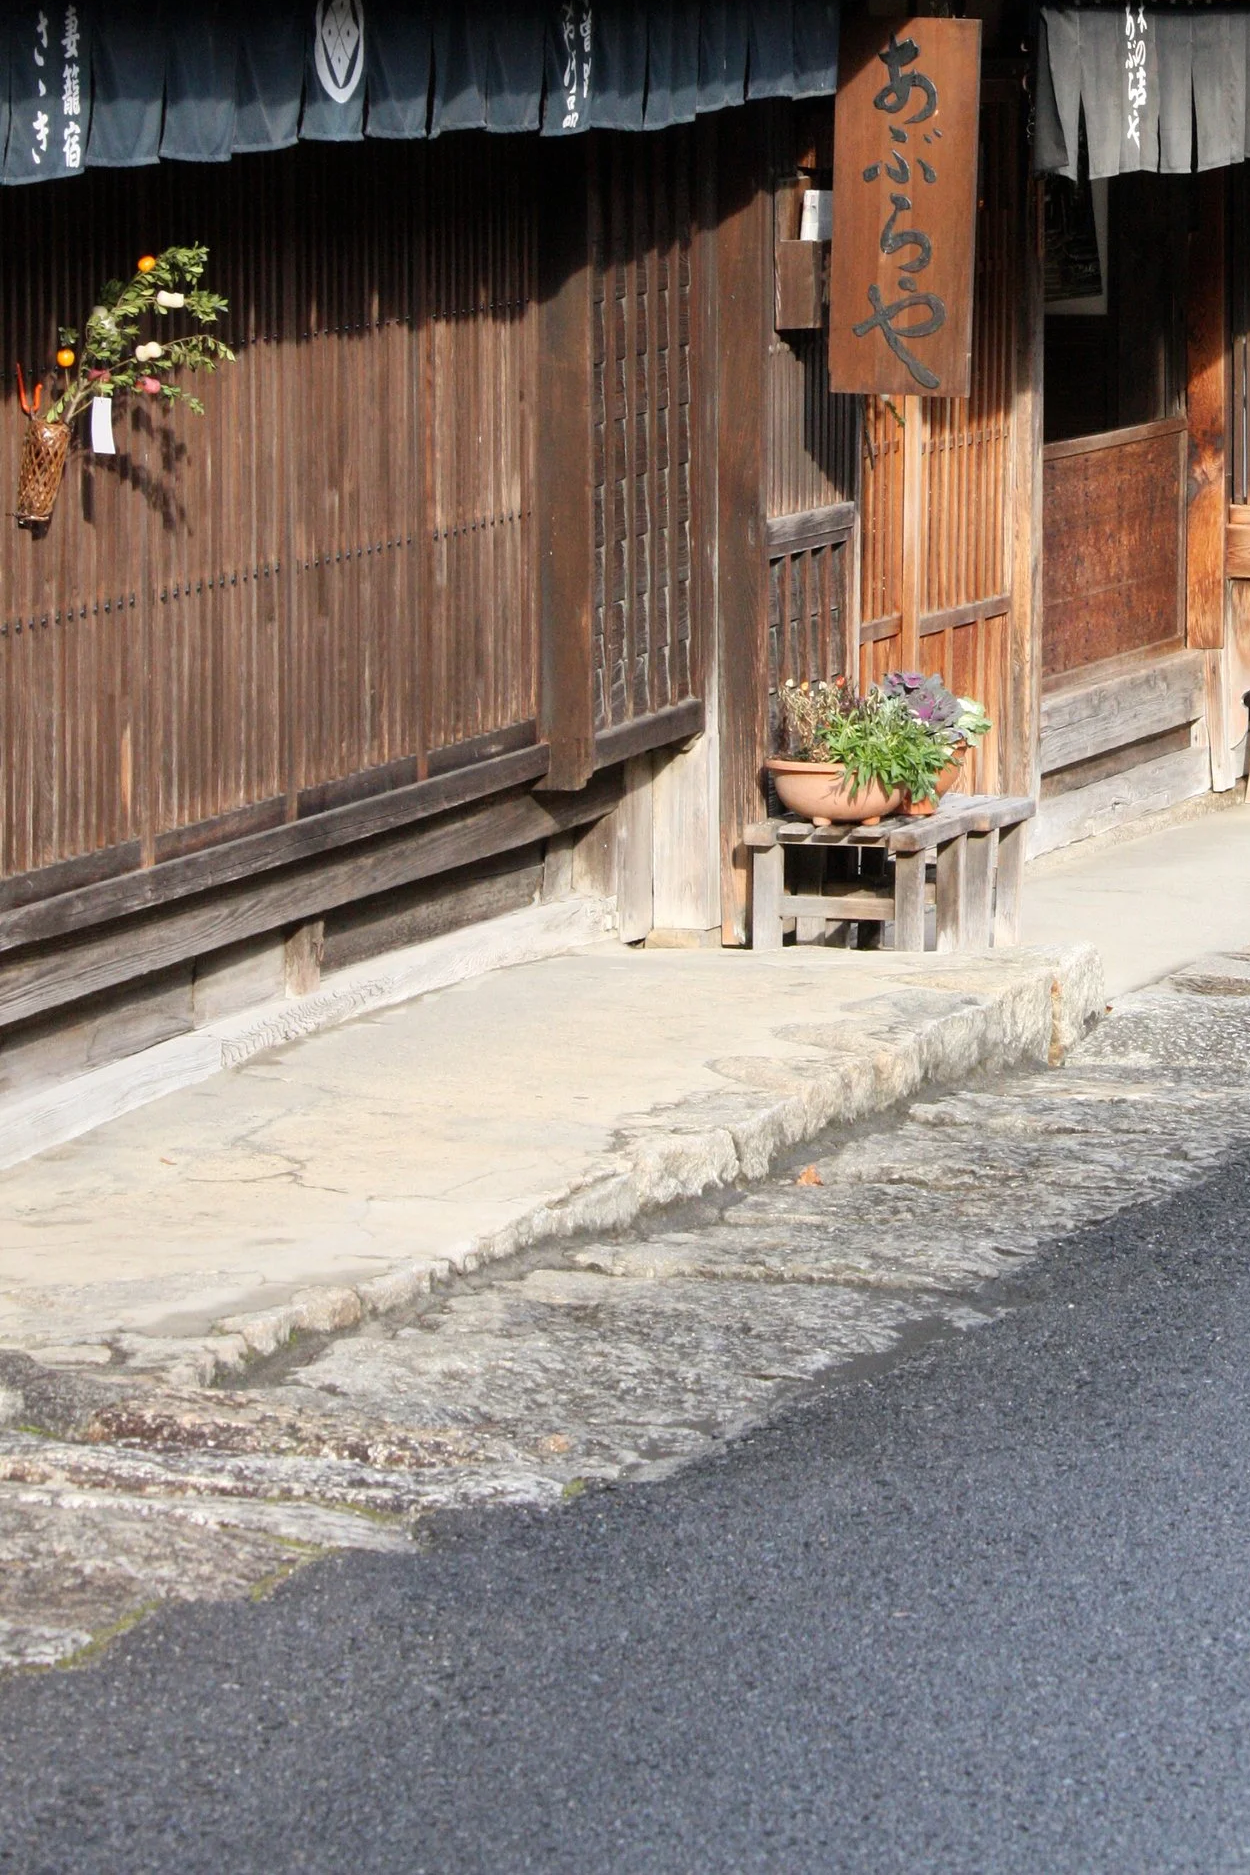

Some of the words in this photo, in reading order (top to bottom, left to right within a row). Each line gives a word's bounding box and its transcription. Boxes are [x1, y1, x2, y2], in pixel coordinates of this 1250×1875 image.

[60, 4, 82, 168] 妻籠宿
[852, 30, 948, 389] あぶらや
